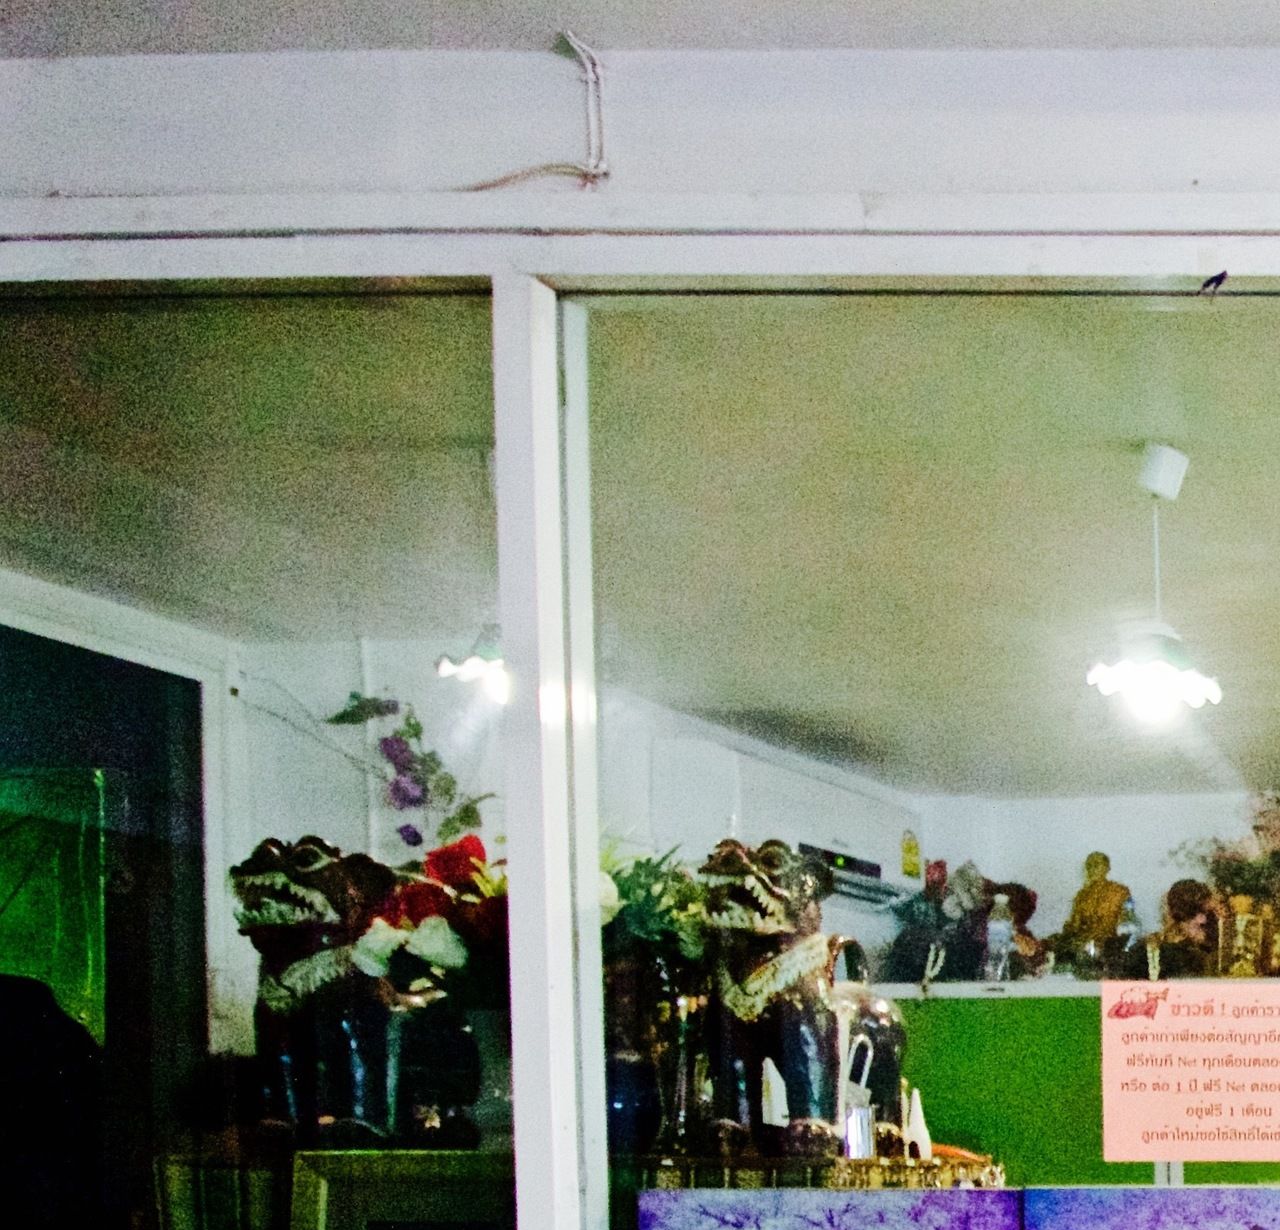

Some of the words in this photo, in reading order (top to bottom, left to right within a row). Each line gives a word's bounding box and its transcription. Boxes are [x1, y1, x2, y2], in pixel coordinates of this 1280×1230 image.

[1171, 994, 1214, 1017] ข่าวดี
[1126, 1053, 1173, 1067] ฟรีทันที
[1178, 1057, 1197, 1067] Net
[1121, 1078, 1147, 1092] หรือ
[1152, 1075, 1170, 1092] ต่อ
[1203, 1078, 1221, 1092] ฟรี
[1226, 1082, 1246, 1092] Net
[1186, 1100, 1222, 1120] อยู่ฟรี
[1241, 1103, 1273, 1117] เดือน
